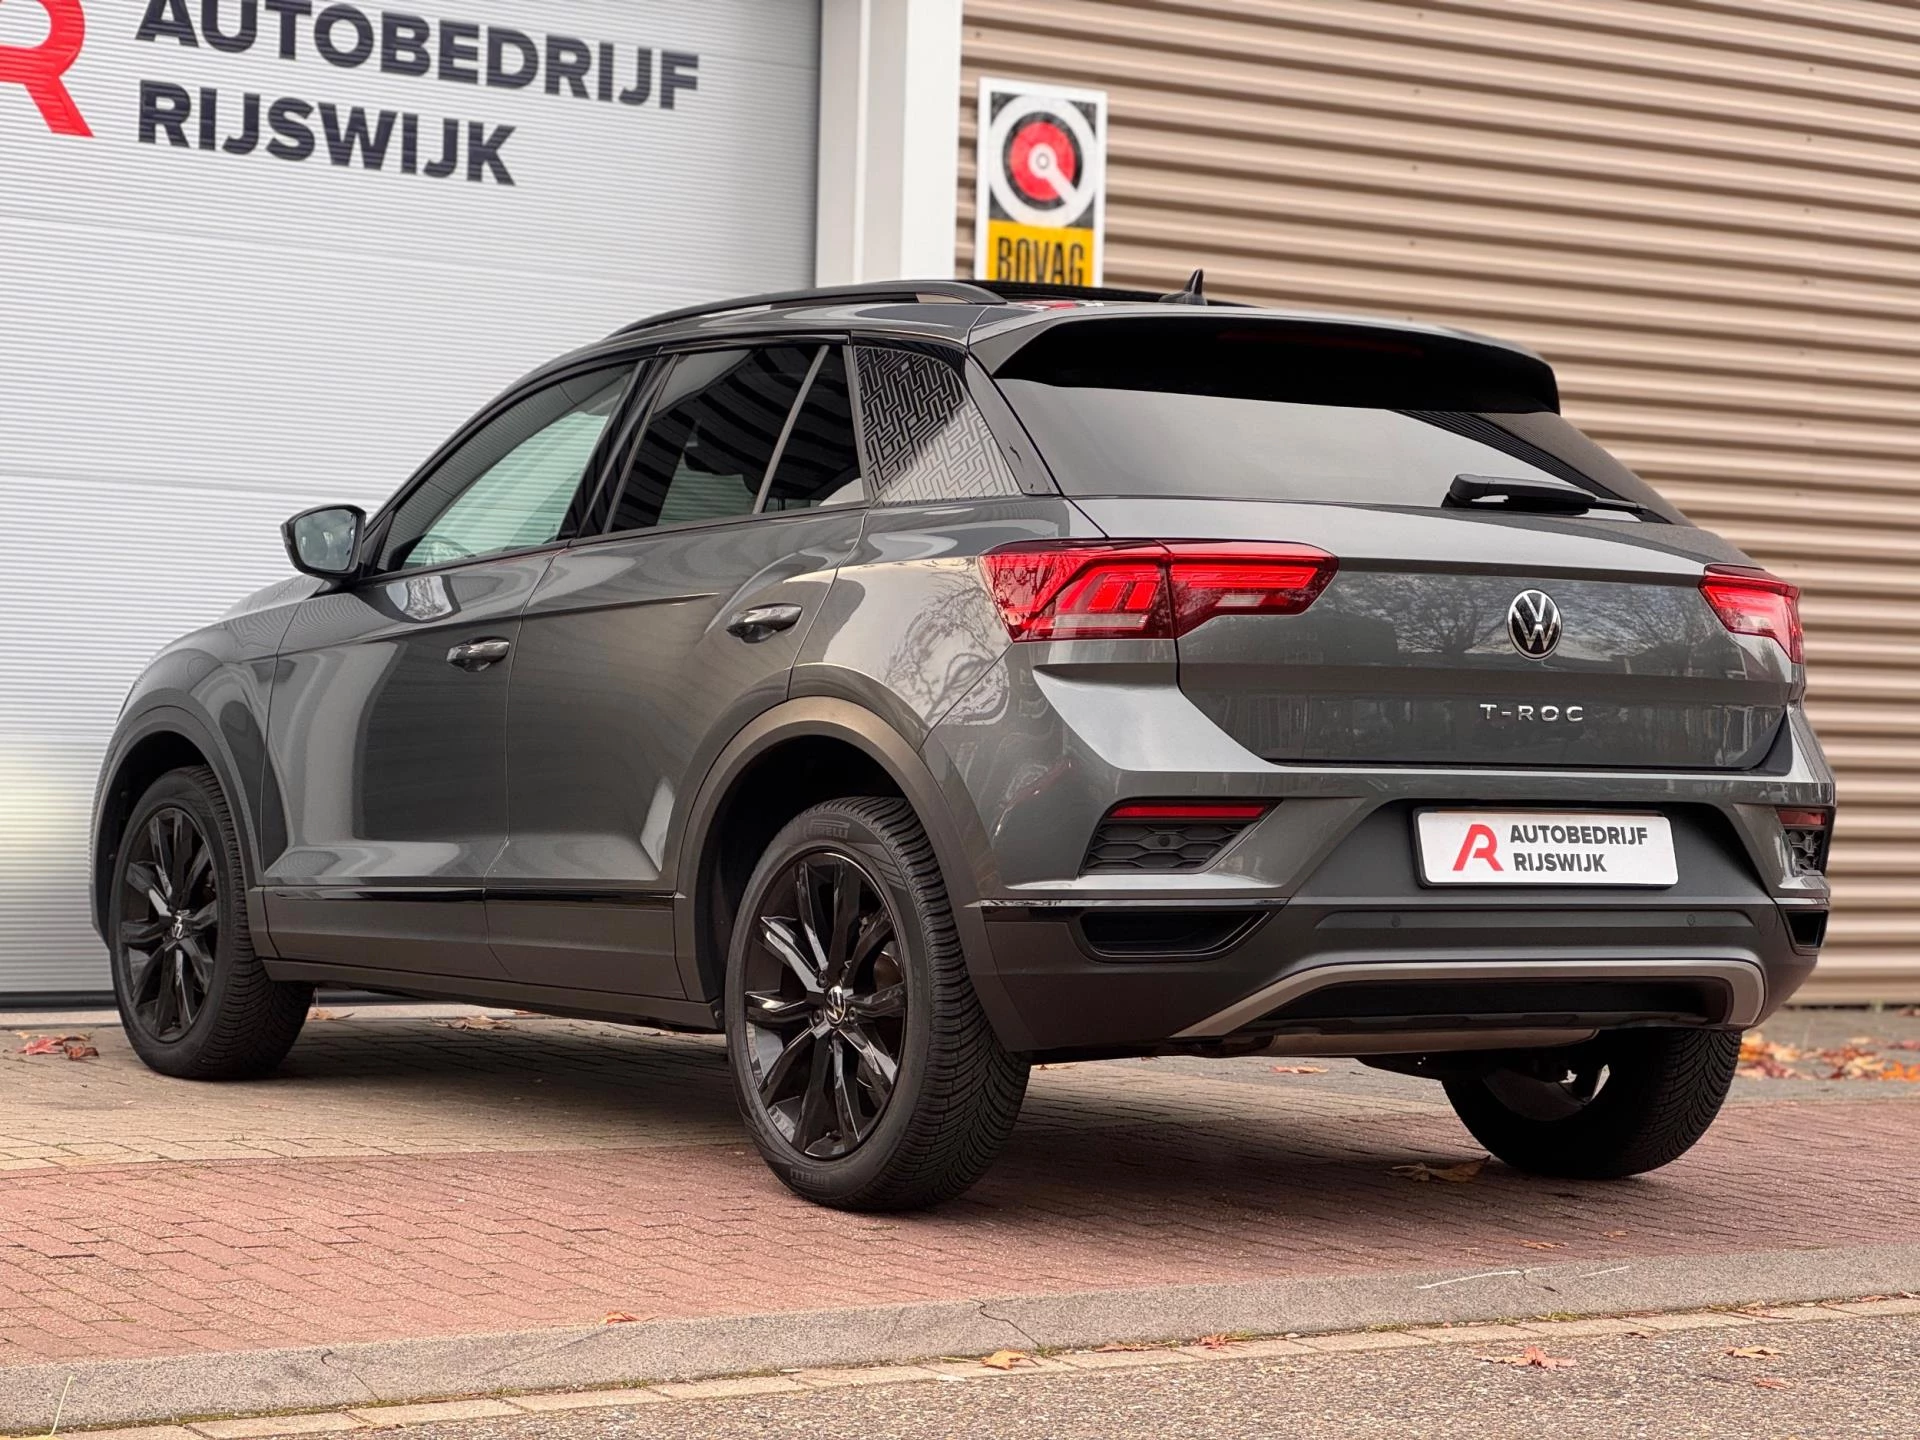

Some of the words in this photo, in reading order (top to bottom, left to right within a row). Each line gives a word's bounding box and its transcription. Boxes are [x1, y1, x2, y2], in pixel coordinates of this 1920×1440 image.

[135, 0, 700, 110] AUTOBEDRIJF
[138, 79, 517, 187] RIJSWIJK
[998, 237, 1084, 286] BOVAG
[1480, 703, 1583, 722] T-ROC
[1510, 824, 1648, 846] AUTOBEDRIJF
[1513, 852, 1607, 873] RIJSWIJK
